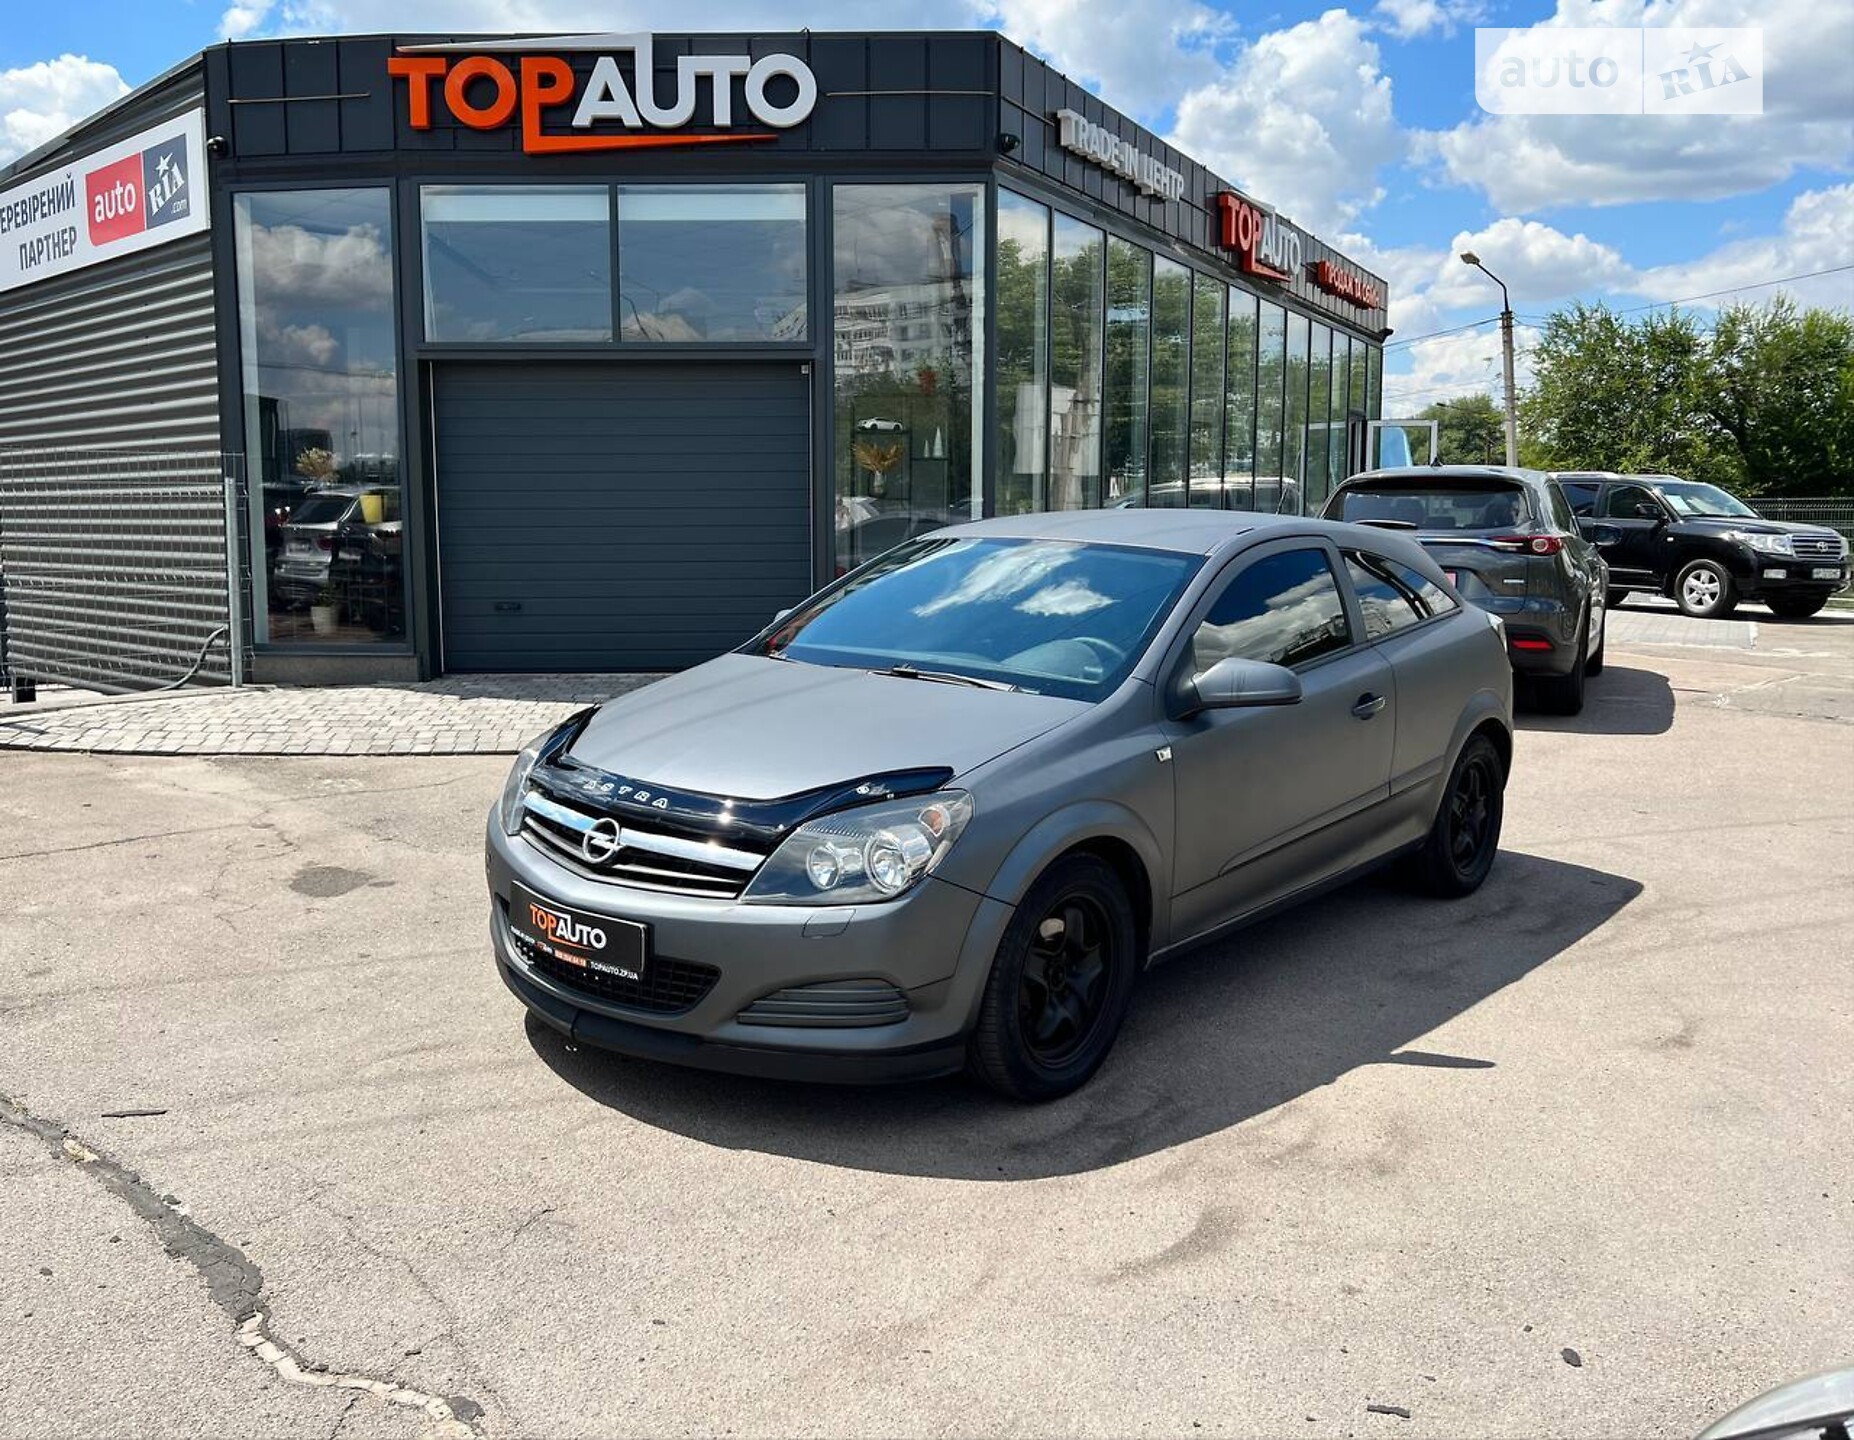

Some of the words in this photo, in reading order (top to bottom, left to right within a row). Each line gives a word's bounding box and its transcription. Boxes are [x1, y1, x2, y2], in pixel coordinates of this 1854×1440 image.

[388, 32, 818, 155] TOPAUTO
[1057, 108, 1139, 181] TRADE-IN
[1138, 153, 1185, 202] ЦЕНТР
[0, 172, 76, 234] ЕРЕВІРЕНИЙ
[94, 180, 137, 223] auto
[148, 162, 185, 217] RIA
[19, 226, 78, 271] ПАРТНЕР
[1219, 188, 1301, 283] TOPAUTO
[583, 780, 669, 809] ASTRA
[529, 902, 608, 951] TOPAUTO
